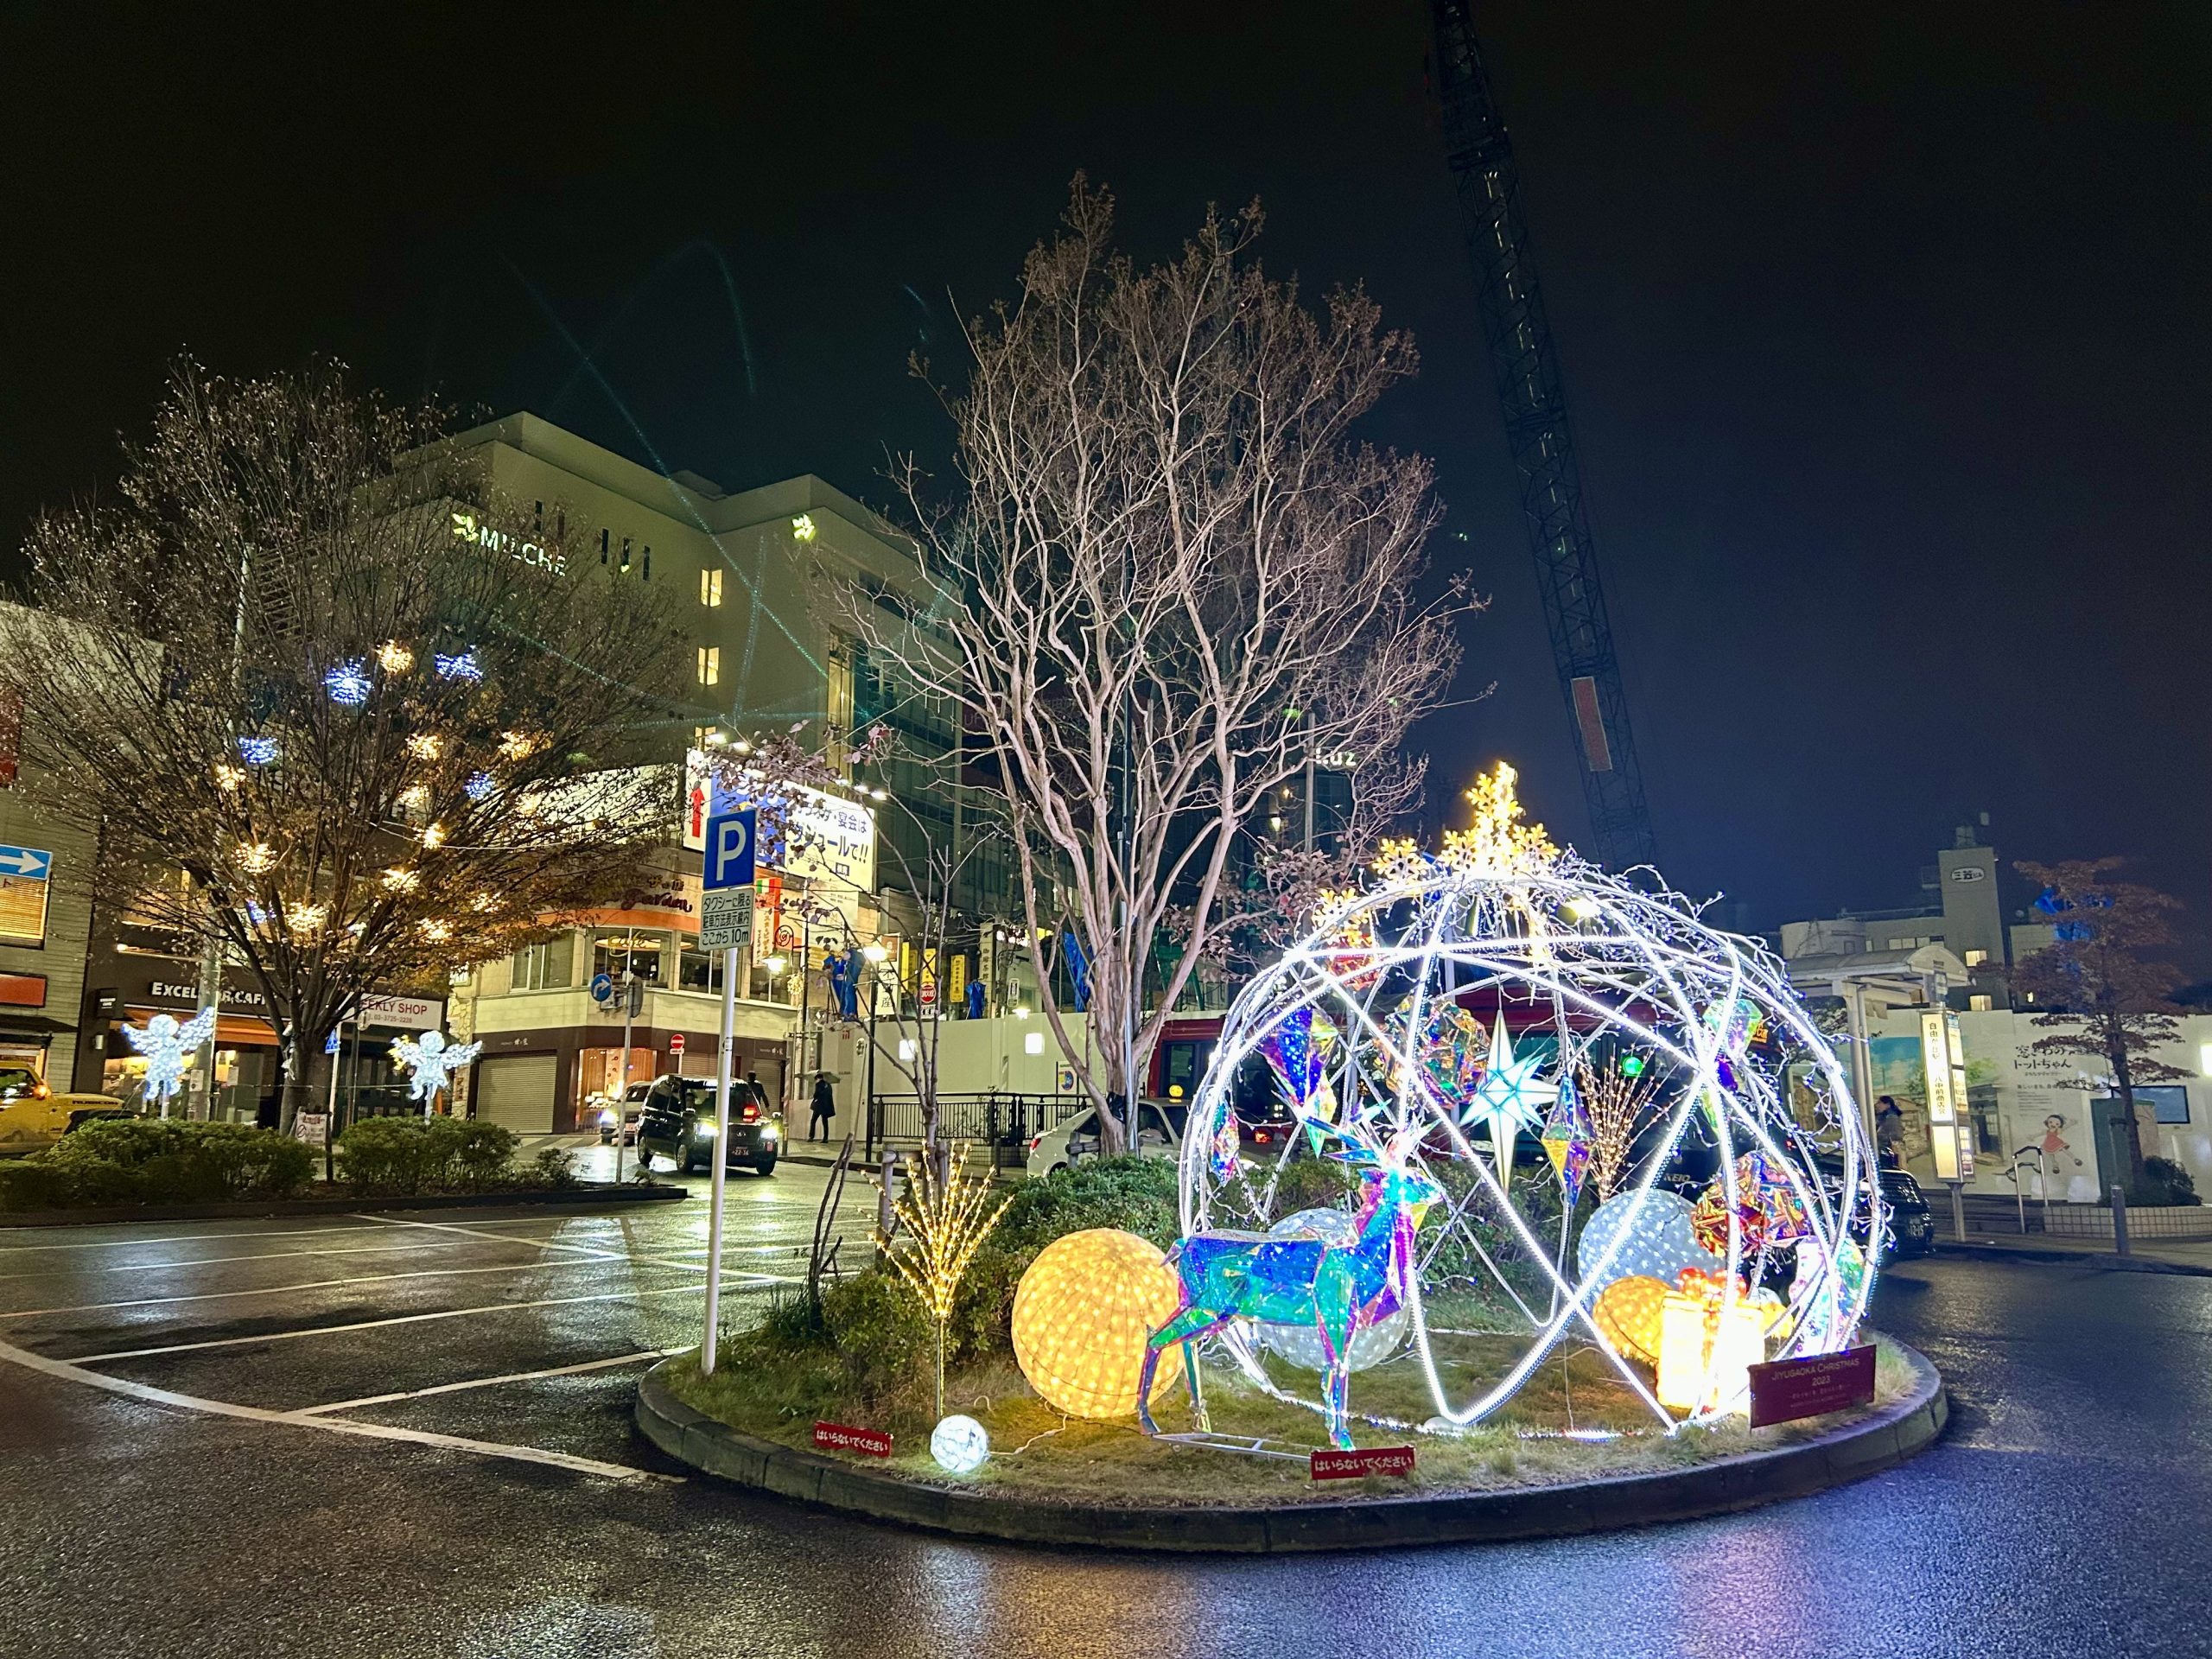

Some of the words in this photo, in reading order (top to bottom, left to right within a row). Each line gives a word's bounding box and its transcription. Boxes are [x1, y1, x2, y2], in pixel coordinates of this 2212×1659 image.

[716, 820, 747, 881] P
[703, 893, 751, 912] タクシーに限る
[702, 931, 729, 946] ここから
[731, 928, 749, 944] 10m
[398, 1002, 428, 1016] SHOP
[2014, 1058, 2072, 1070] トットちゃん
[1811, 1375, 1832, 1388] 2023
[816, 1430, 889, 1452] はいらないでください
[1314, 1456, 1413, 1472] はいらないでください
